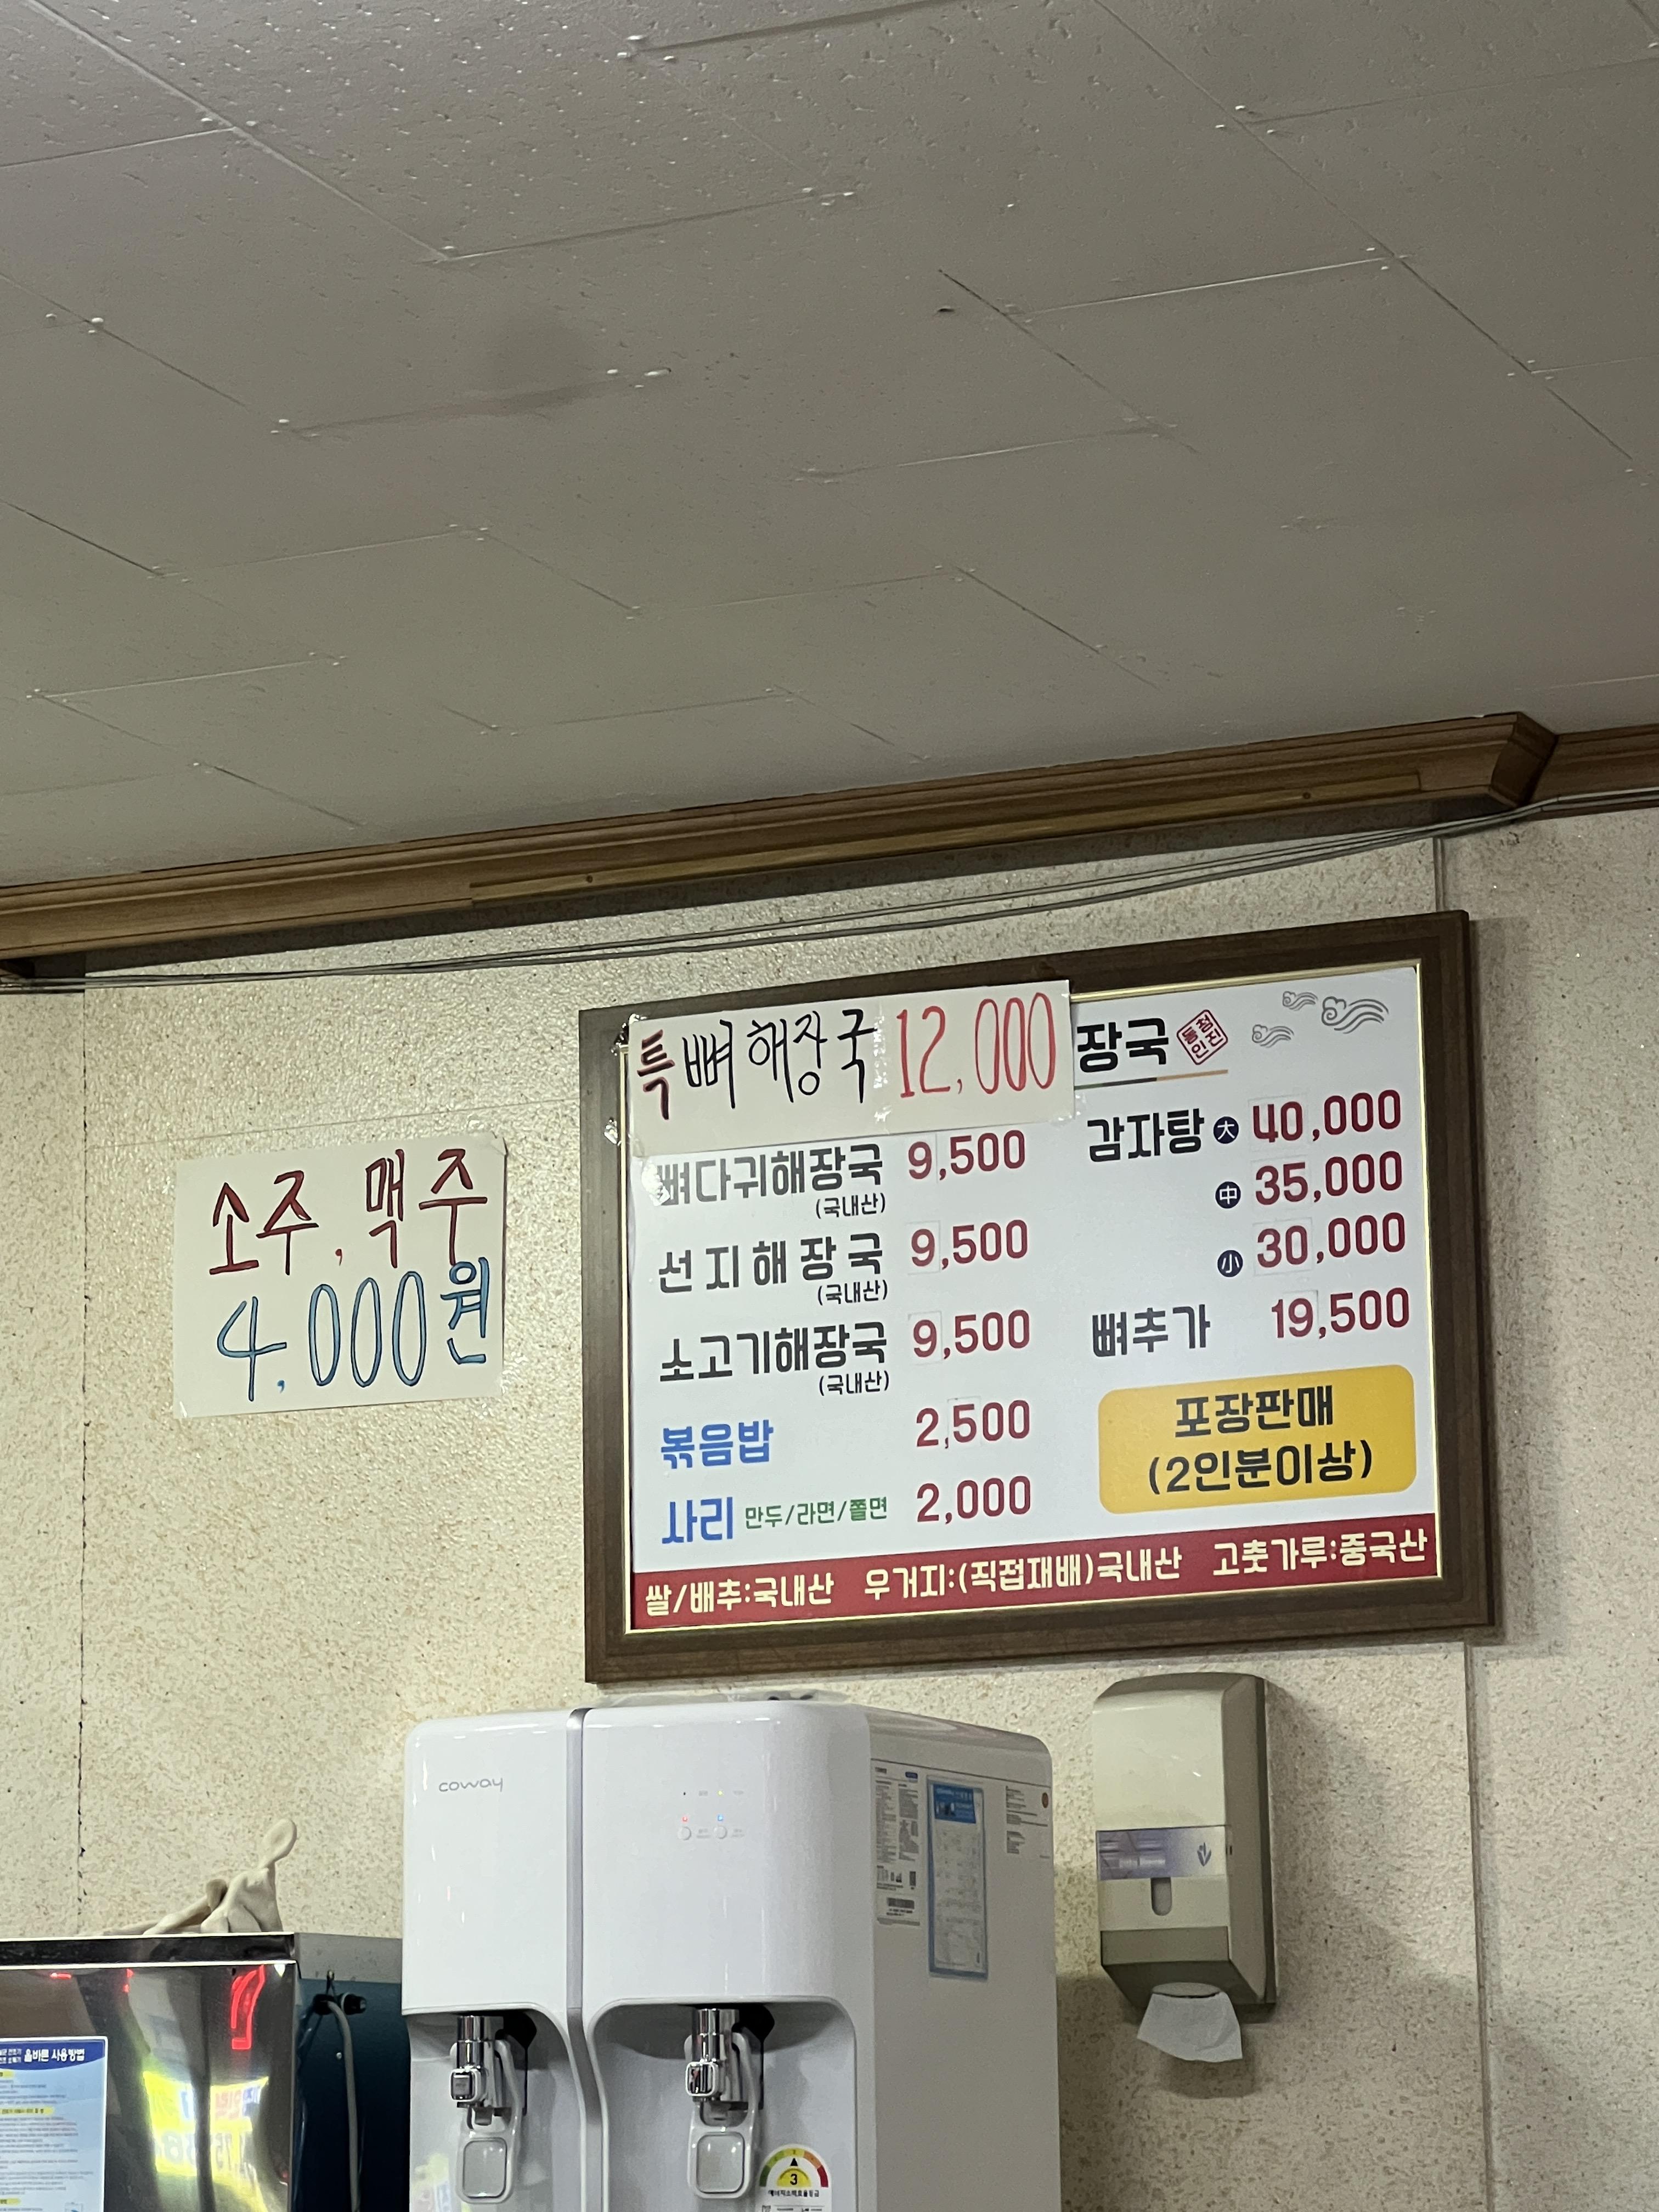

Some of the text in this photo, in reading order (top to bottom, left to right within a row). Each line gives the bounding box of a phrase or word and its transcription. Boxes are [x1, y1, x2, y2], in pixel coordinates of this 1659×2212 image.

[895, 992, 1057, 1098] 12,000
[1087, 1108, 1205, 1163] 감자탕
[1252, 1089, 1401, 1143] 40,000
[657, 1129, 1026, 1206] 뼈다귀해장국 9,500
[1255, 1151, 1403, 1206] 35,000
[364, 1148, 488, 1269] 맥주
[815, 1192, 887, 1220] (국내산)
[910, 1219, 1029, 1271] 9,500
[1256, 1212, 1406, 1269] 30,000
[817, 1279, 889, 1307] (국내산)
[659, 1309, 1030, 1383] 소고기해장국 9,500
[1092, 1287, 1409, 1358] 뼈추가 19,500
[818, 1370, 890, 1397] (국내산)
[1175, 1385, 1334, 1438] 포장판매
[661, 1400, 1031, 1470] 볶음밥 2,500
[1148, 1439, 1373, 1495] (2인분이상)
[661, 1497, 734, 1545] 사리
[916, 1475, 1031, 1525] 2,000
[438, 1776, 504, 1793] coway
[789, 2173, 798, 2186] 3
